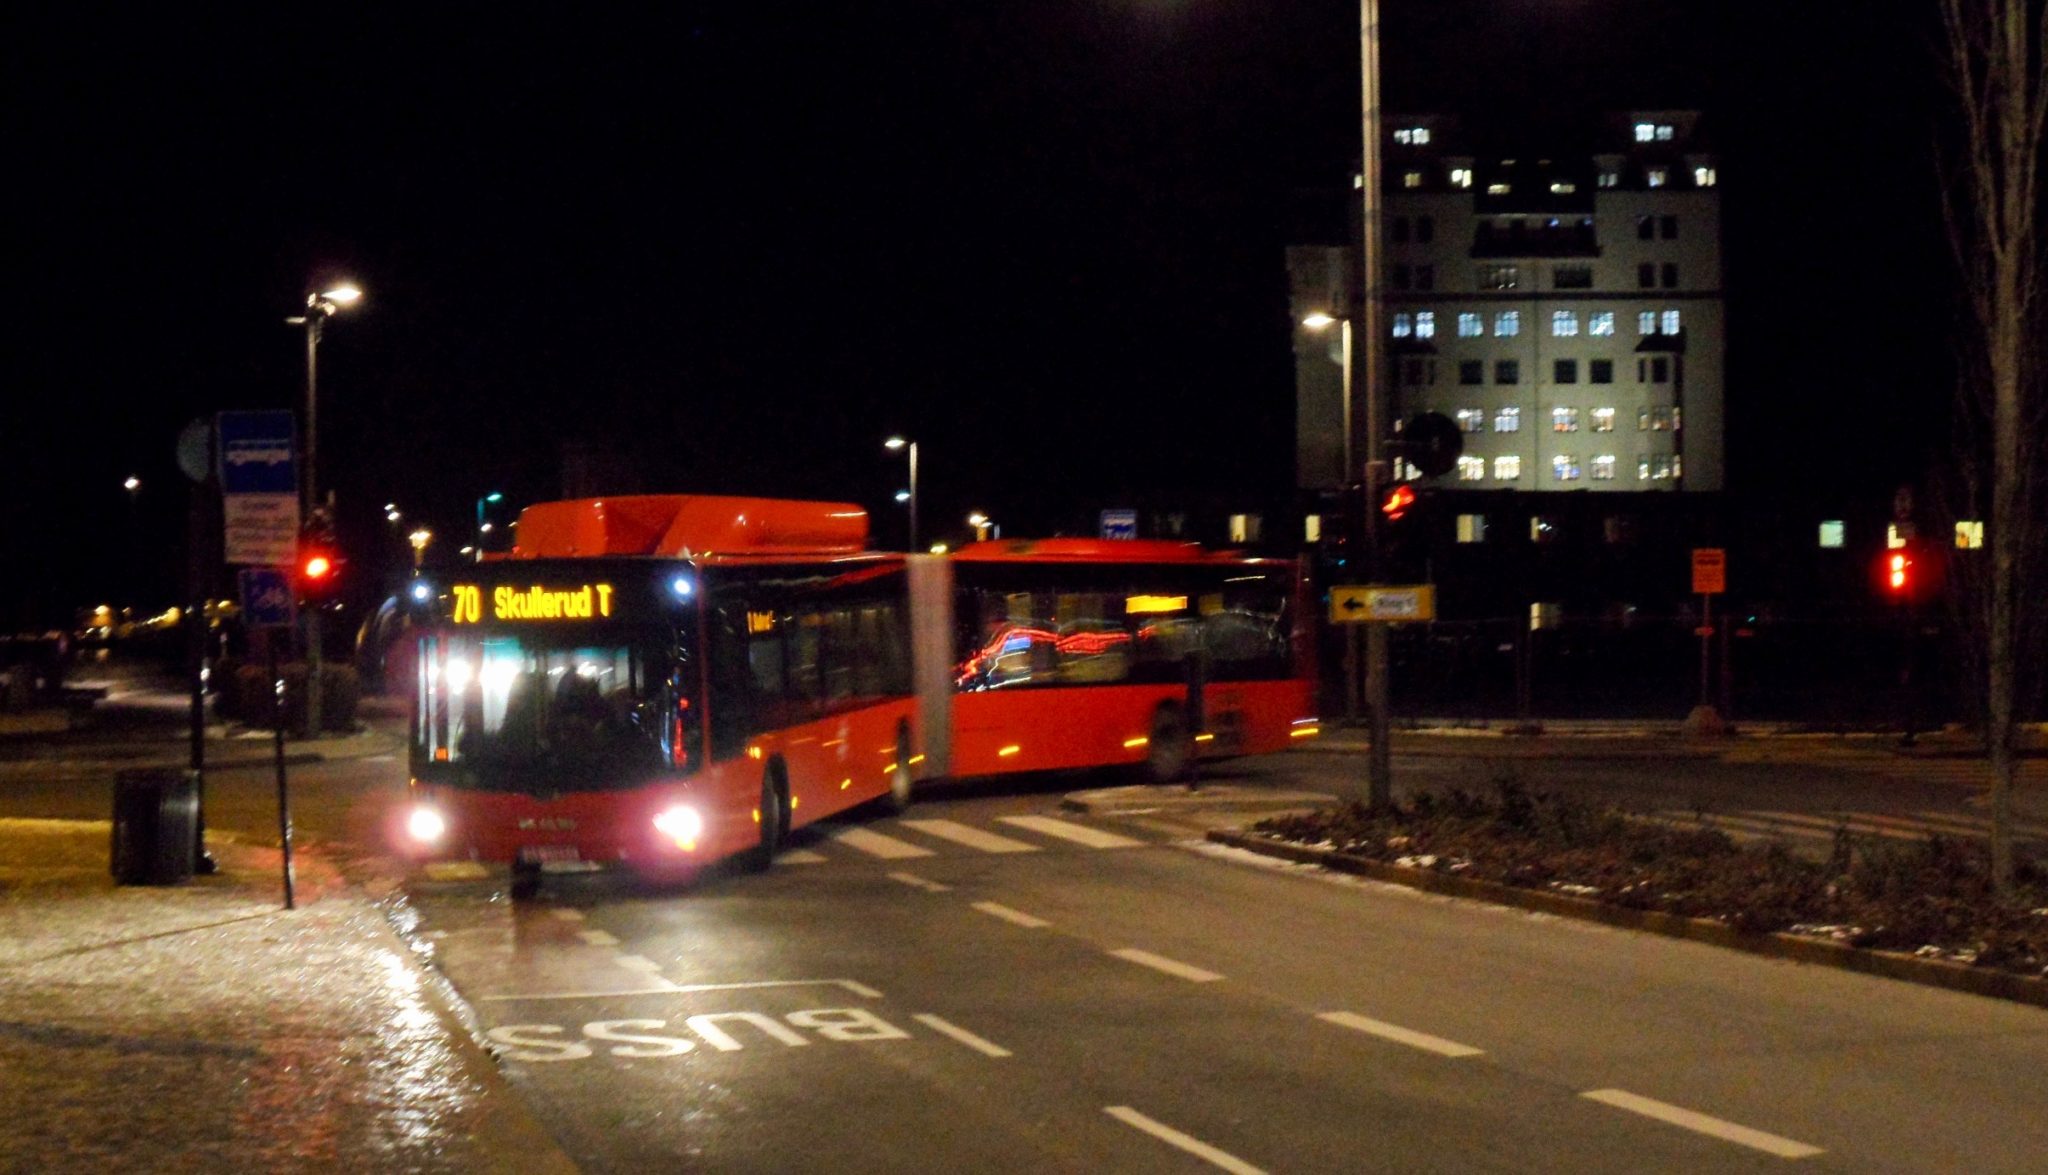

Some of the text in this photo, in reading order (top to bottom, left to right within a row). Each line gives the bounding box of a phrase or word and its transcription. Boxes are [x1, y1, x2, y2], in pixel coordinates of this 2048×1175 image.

[453, 584, 612, 623] 70 Skullerud T
[487, 1008, 910, 1062] BUSS
